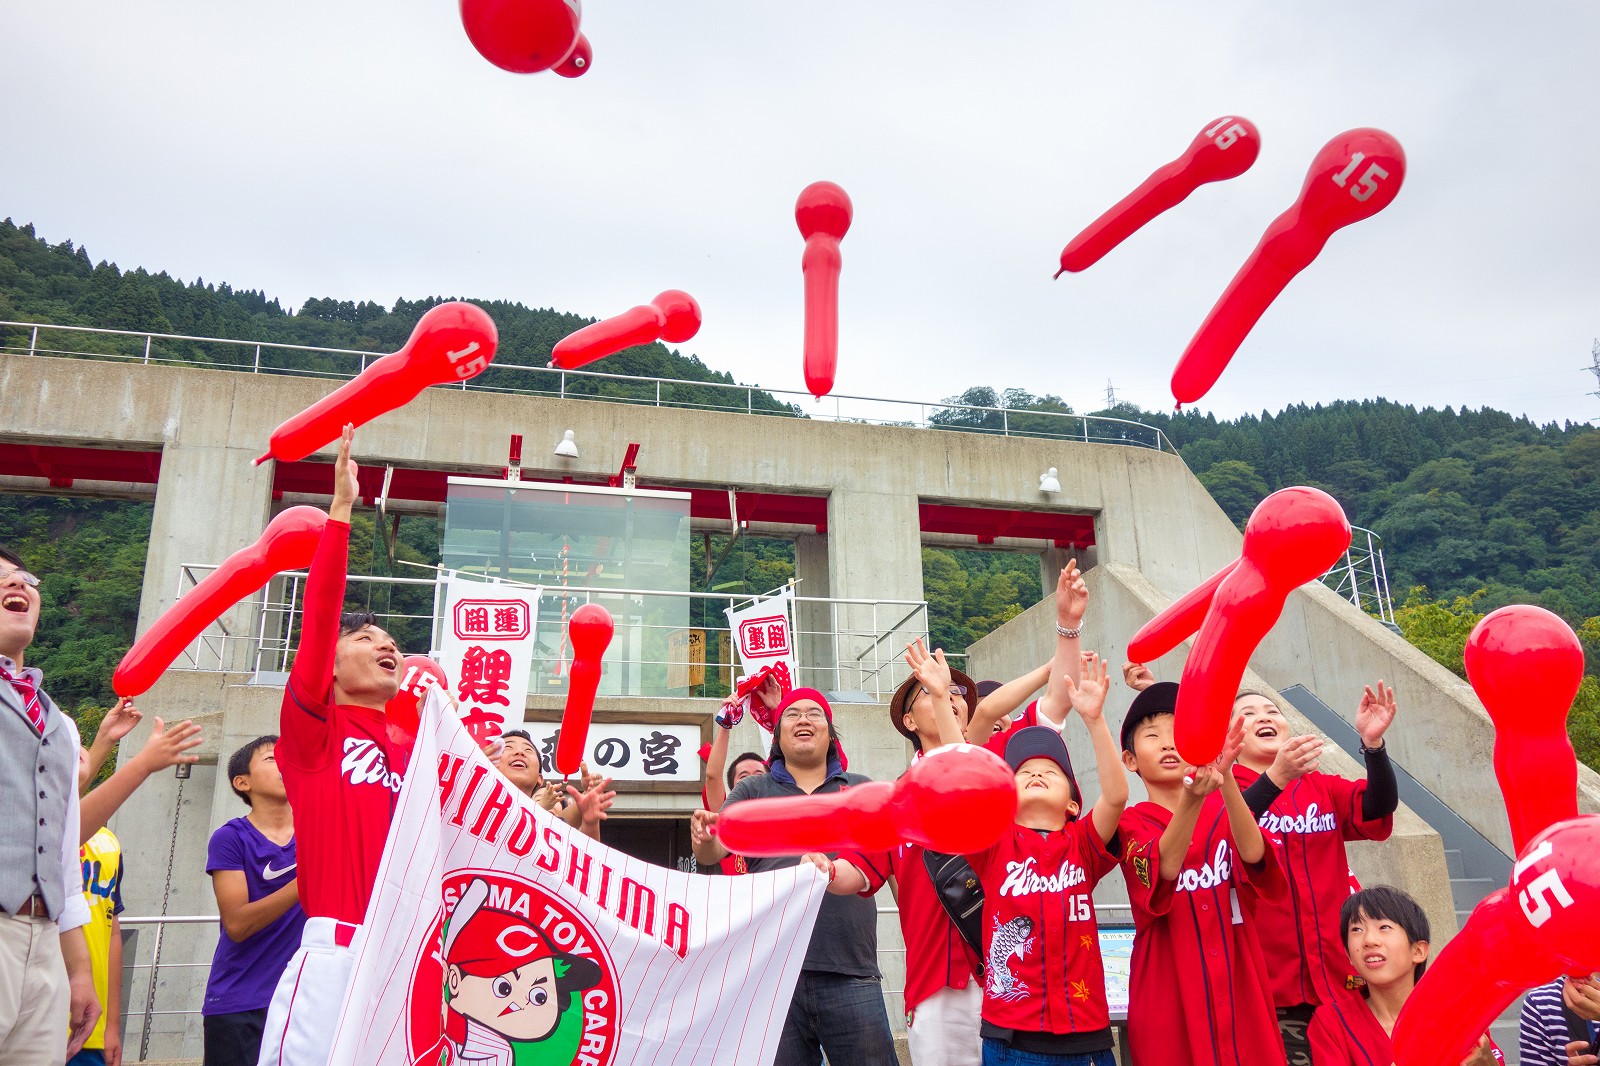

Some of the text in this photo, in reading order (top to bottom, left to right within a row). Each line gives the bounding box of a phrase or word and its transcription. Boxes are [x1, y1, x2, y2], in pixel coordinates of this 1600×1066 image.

[1204, 117, 1248, 151] 15
[1332, 151, 1389, 202] 15
[446, 341, 487, 378] 15
[464, 607, 520, 632] 開運
[400, 665, 438, 698] 15
[341, 737, 403, 793] Hiro
[1258, 802, 1336, 834] iroshim
[437, 751, 692, 963] HIROSHIMA
[1000, 856, 1087, 897] Hiroshim
[1513, 840, 1575, 929] 15
[1068, 893, 1091, 921] 15
